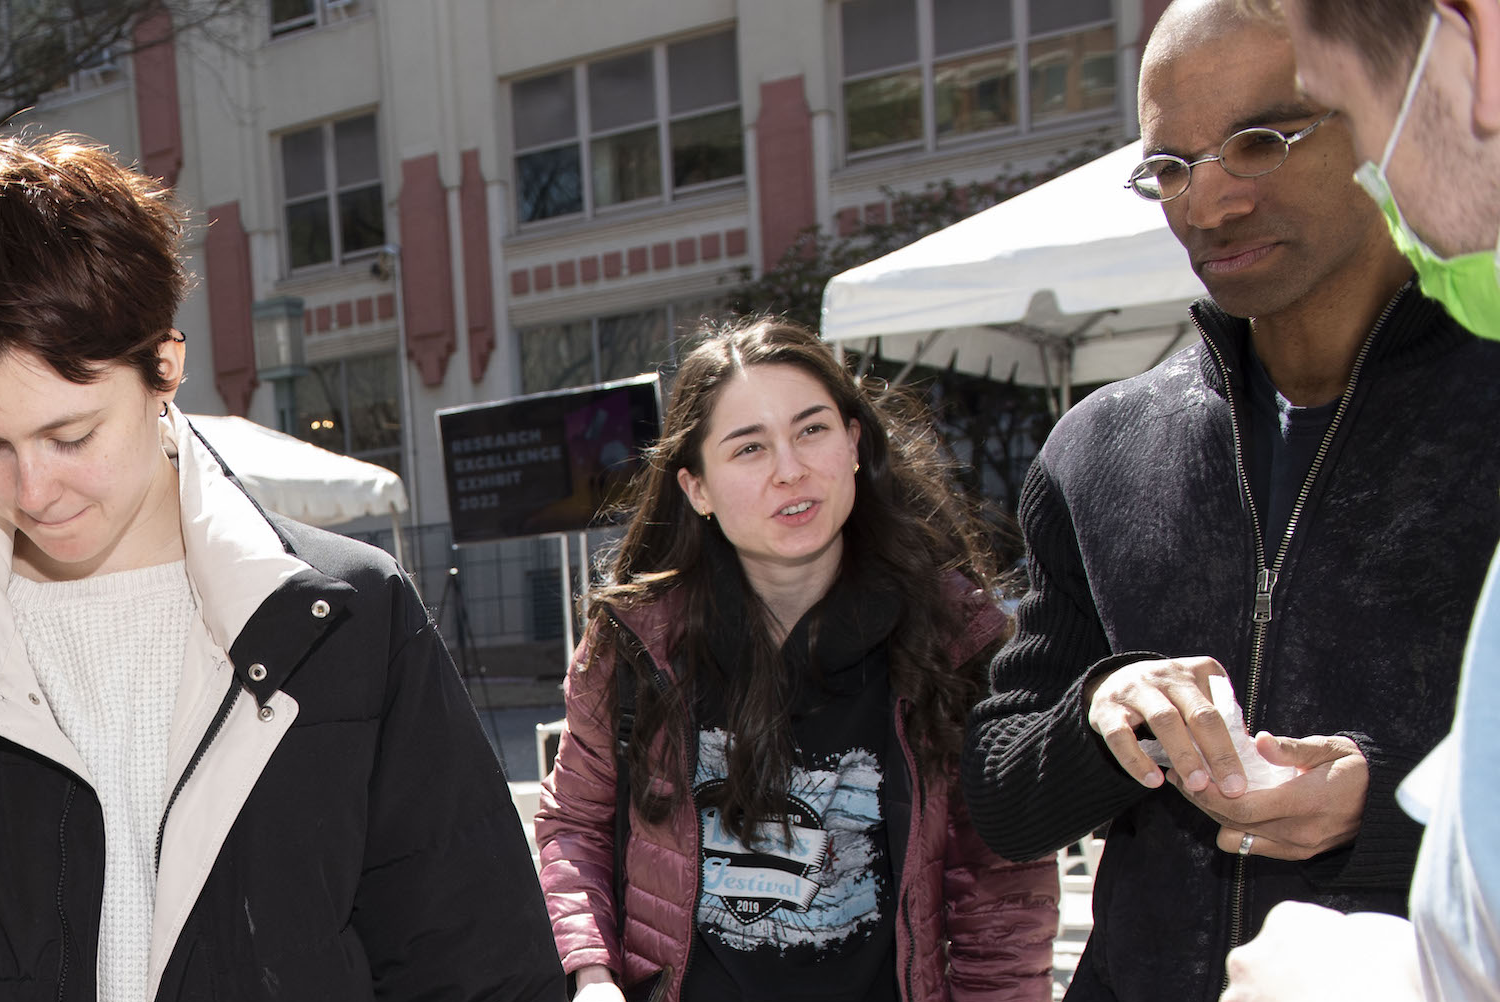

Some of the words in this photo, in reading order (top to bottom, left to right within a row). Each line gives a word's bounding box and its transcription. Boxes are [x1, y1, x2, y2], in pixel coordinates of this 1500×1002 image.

[451, 428, 541, 454] RESEARCH
[453, 445, 563, 473] EXCELLENCE
[455, 469, 523, 492] EXHIBIT
[458, 492, 500, 511] 2022
[702, 856, 803, 898] Festival
[736, 900, 760, 913] 2019
